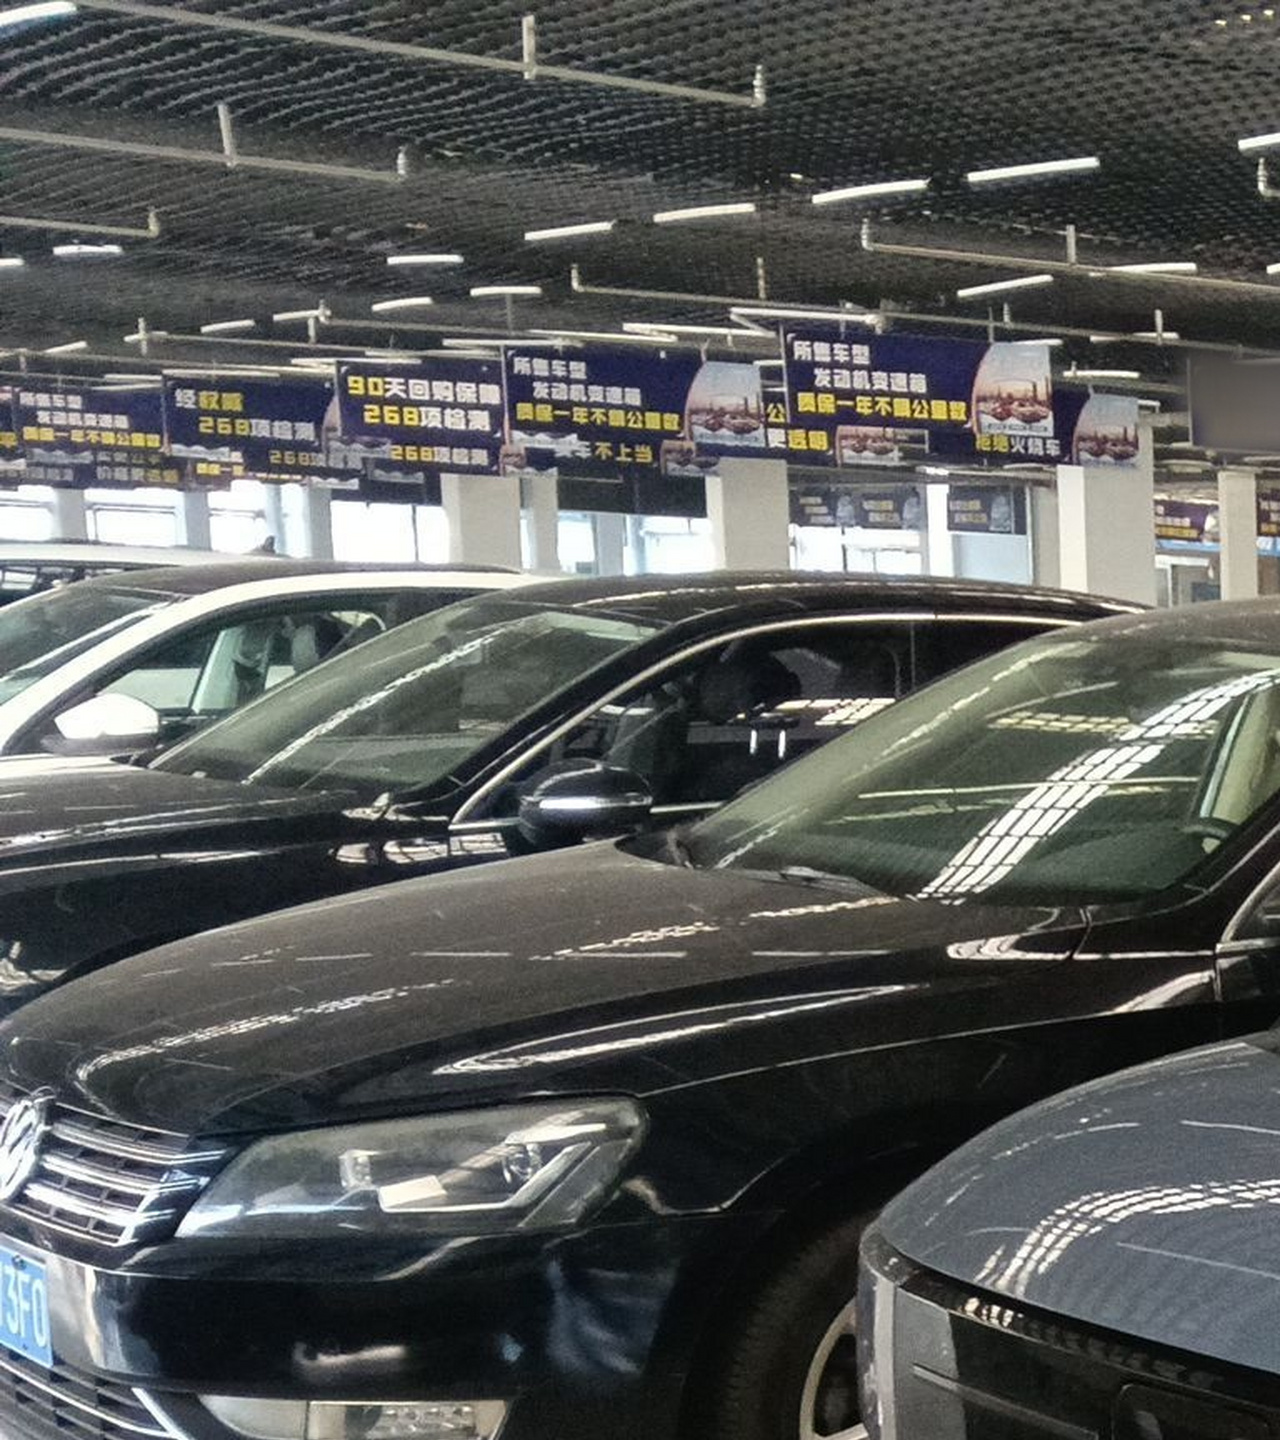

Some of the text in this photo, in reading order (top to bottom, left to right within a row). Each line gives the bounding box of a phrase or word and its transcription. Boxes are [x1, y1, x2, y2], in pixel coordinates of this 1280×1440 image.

[792, 340, 870, 365] 所售车型
[513, 357, 587, 380] 所售车型
[814, 367, 927, 393] 发动机变速箱
[347, 376, 500, 404] 90天回购保障
[532, 381, 641, 406] 发动机变速箱
[364, 405, 491, 431] 268项检测
[516, 402, 680, 431] 质保一年不限公里数
[798, 391, 967, 421] 质保一年不限公里数
[199, 416, 316, 442] 268项检测
[390, 445, 489, 467] 268项检测
